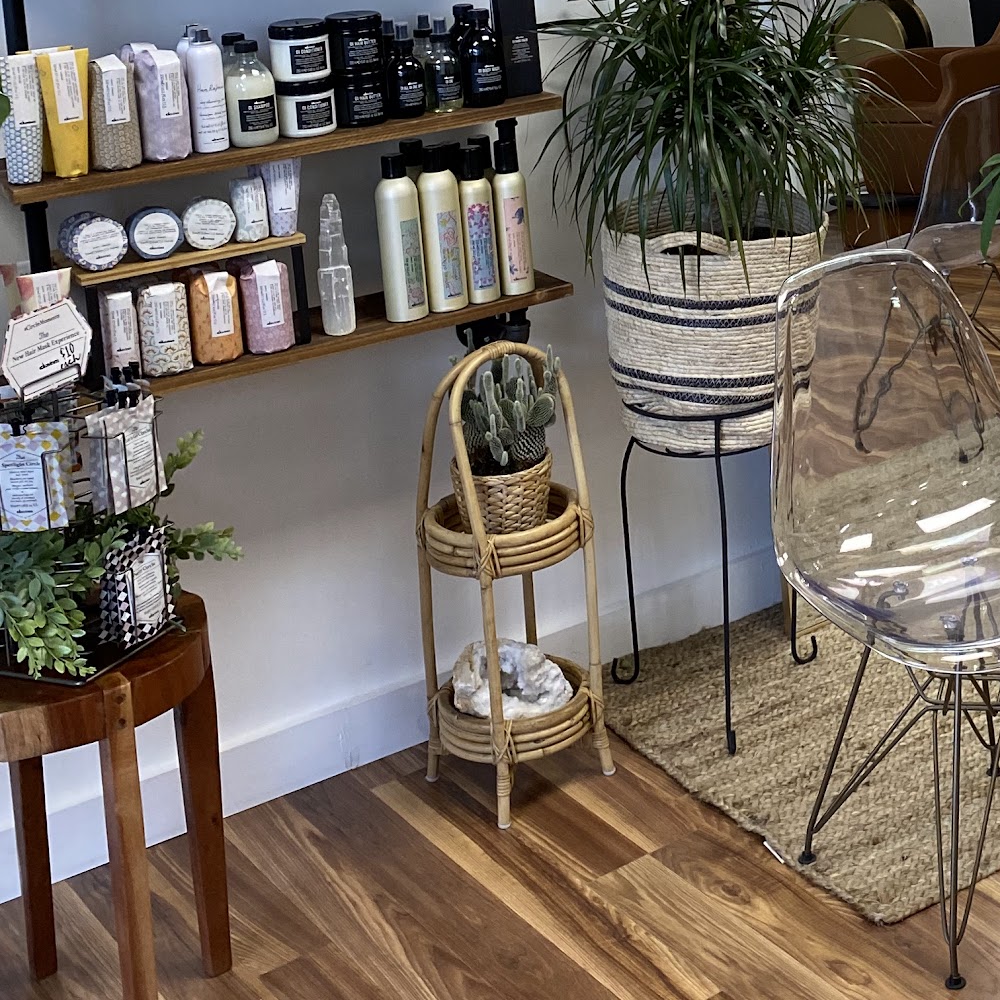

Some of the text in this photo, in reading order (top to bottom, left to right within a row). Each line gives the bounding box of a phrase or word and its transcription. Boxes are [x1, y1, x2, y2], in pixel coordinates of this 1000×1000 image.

[12, 331, 80, 362] New Hair Mask Experience
